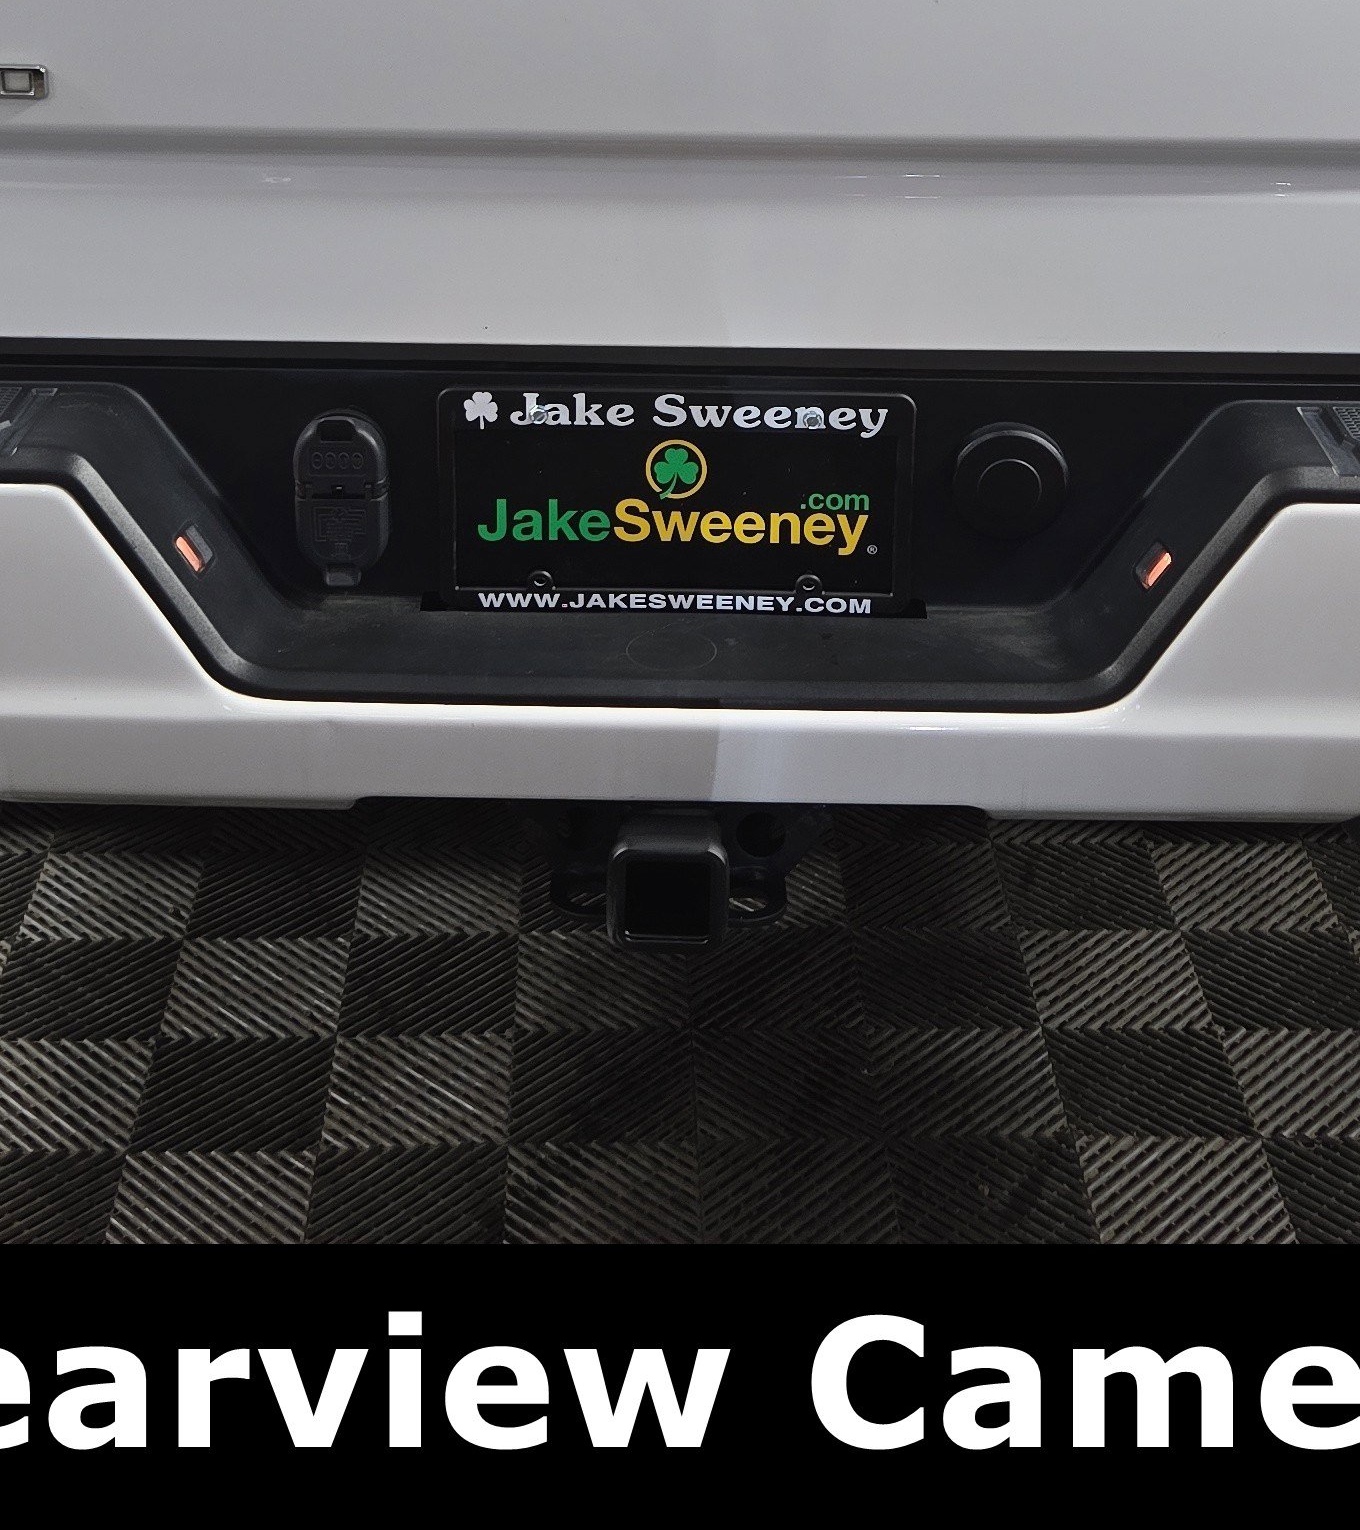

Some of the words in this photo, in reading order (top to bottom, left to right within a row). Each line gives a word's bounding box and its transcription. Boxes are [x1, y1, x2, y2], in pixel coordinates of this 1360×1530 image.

[510, 392, 635, 426] Jake
[653, 394, 888, 438] Sweeney
[478, 592, 871, 614] WWW.JAKESWEENEY.COM
